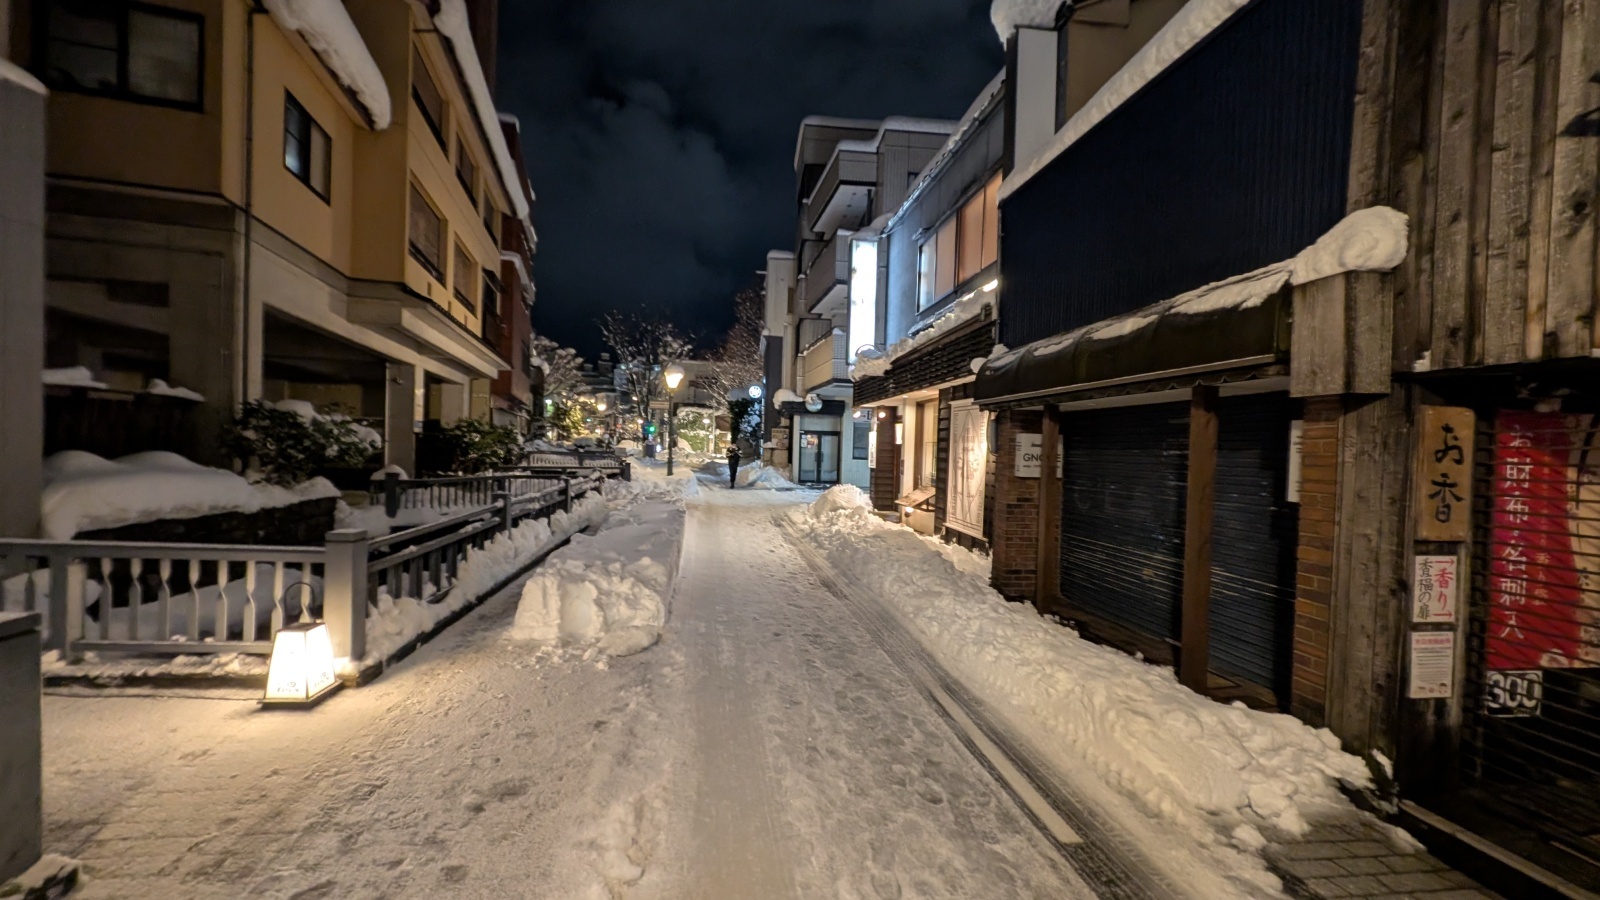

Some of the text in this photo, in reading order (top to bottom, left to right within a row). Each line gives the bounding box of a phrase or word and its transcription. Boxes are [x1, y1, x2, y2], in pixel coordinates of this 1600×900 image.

[1428, 423, 1464, 523] お香
[1434, 567, 1454, 611] 香り
[1488, 673, 1540, 708] 300
